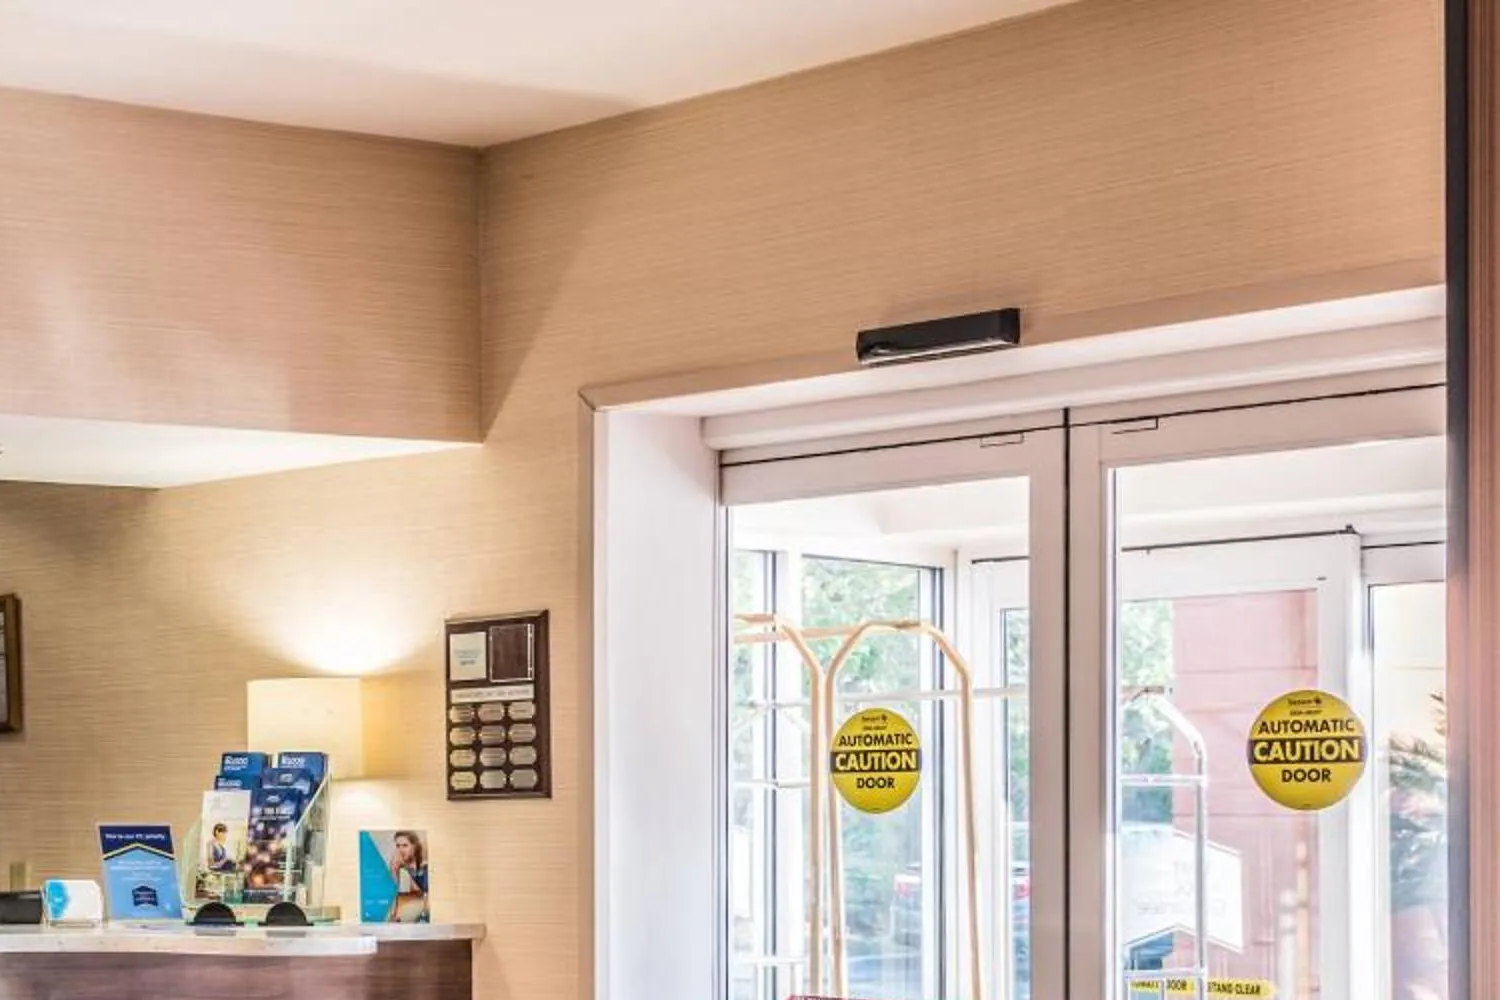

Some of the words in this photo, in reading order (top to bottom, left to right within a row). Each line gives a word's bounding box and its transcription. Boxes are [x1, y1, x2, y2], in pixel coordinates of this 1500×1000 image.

[1258, 719, 1356, 734] AUTOMATIC
[838, 733, 913, 747] AUTOMATIC
[1253, 739, 1359, 761] CAUTION
[835, 751, 916, 771] CAUTION
[856, 776, 895, 789] DOOR
[1281, 768, 1332, 783] DOOR
